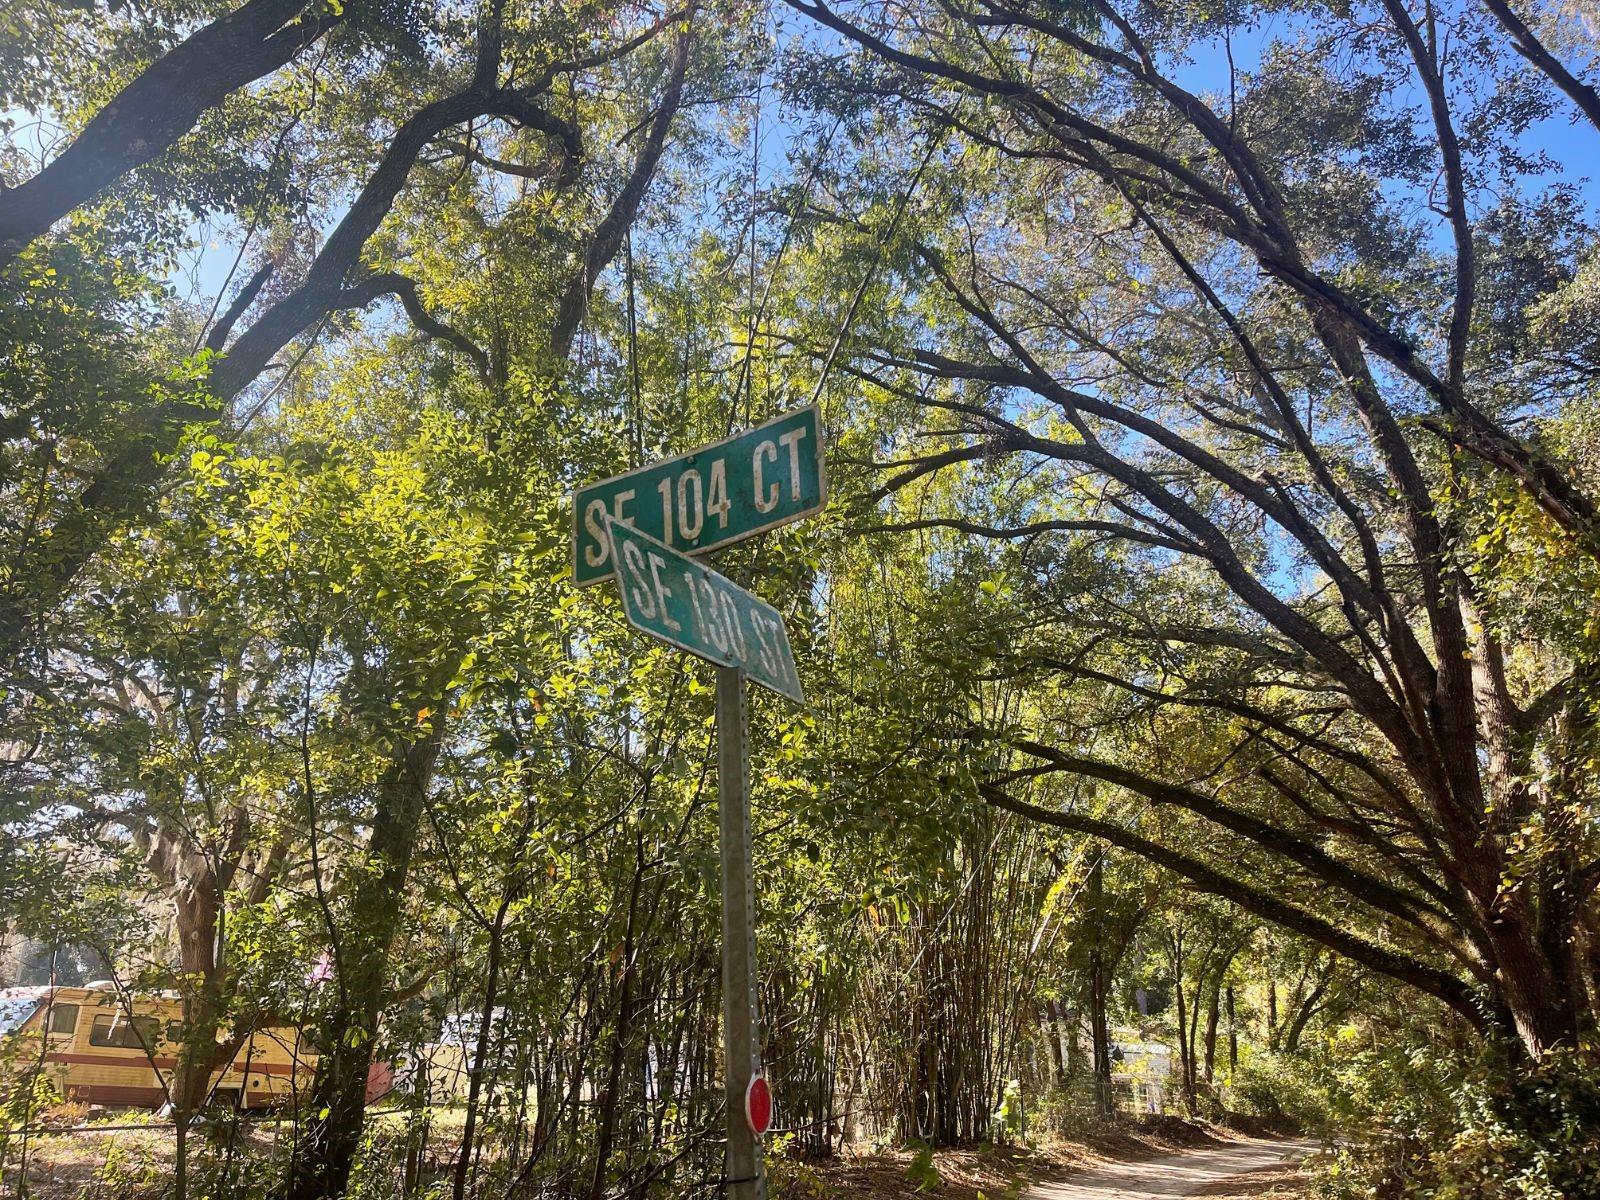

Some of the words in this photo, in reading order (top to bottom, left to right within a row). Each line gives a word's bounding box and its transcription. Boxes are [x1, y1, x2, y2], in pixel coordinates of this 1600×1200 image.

[657, 458, 731, 546] 104
[753, 426, 807, 514] CT
[622, 539, 682, 632] SE
[683, 571, 748, 663] 130
[750, 608, 790, 684] ST
